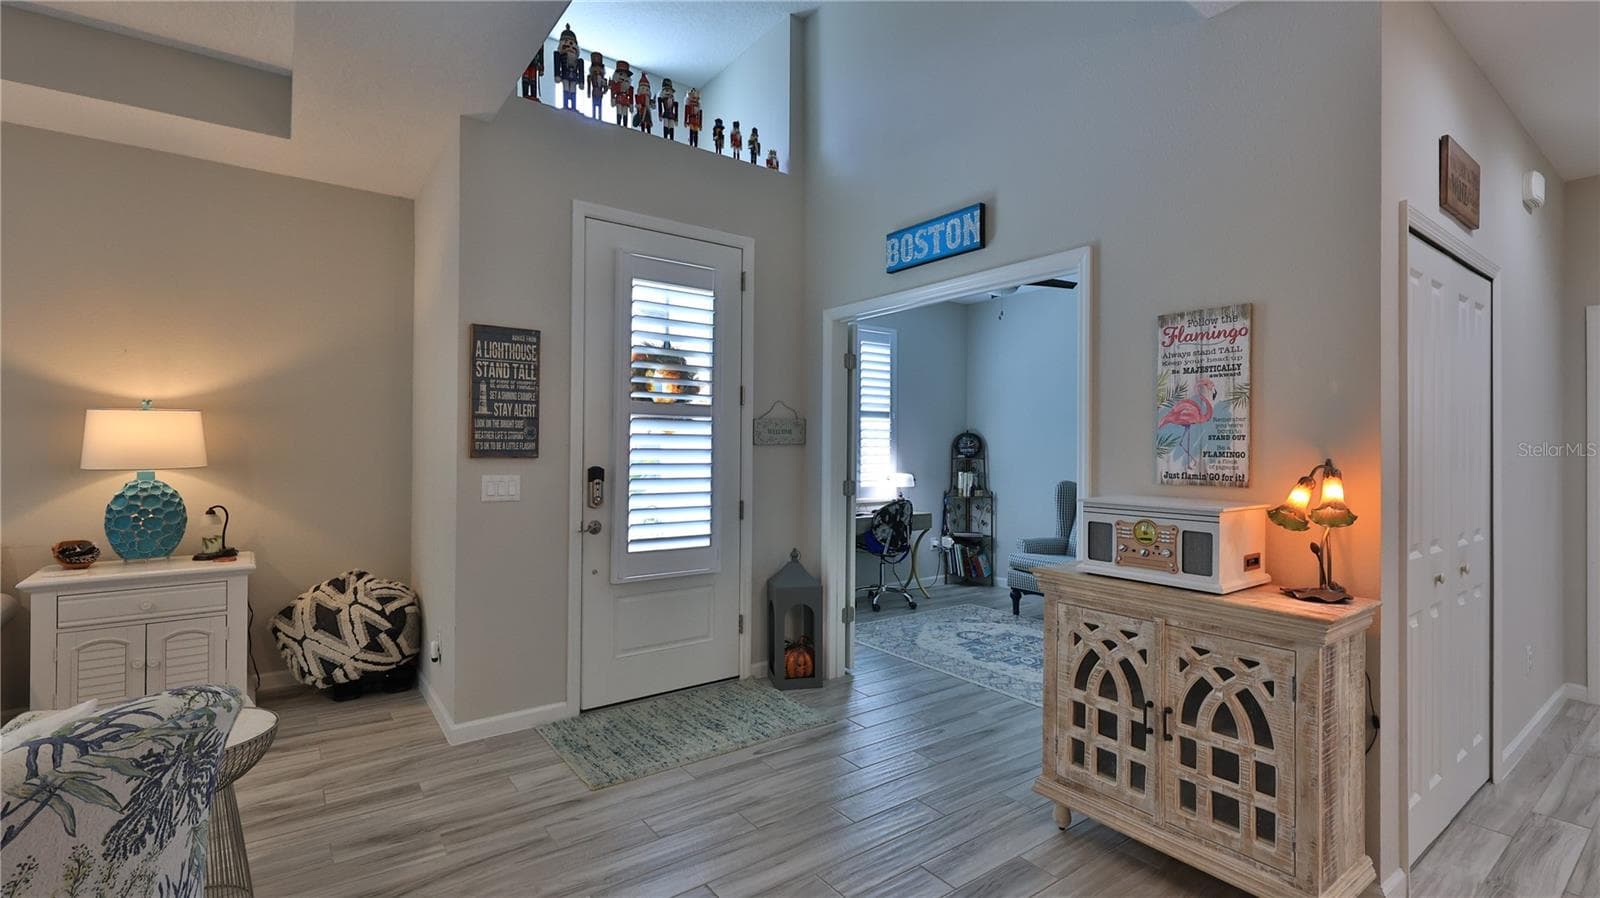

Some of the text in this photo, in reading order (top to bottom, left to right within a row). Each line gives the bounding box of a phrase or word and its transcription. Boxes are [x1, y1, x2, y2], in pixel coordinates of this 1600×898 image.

[886, 207, 980, 266] BOSTON
[1187, 313, 1238, 327] Follow the
[1162, 325, 1248, 348] Flamingo
[476, 340, 536, 360] A LIGHTHOUSE
[1162, 351, 1191, 359] Always
[476, 360, 536, 380] STAND TALL
[1183, 363, 1242, 374] MAJESTICALLY
[494, 403, 536, 418] STAY ALERT
